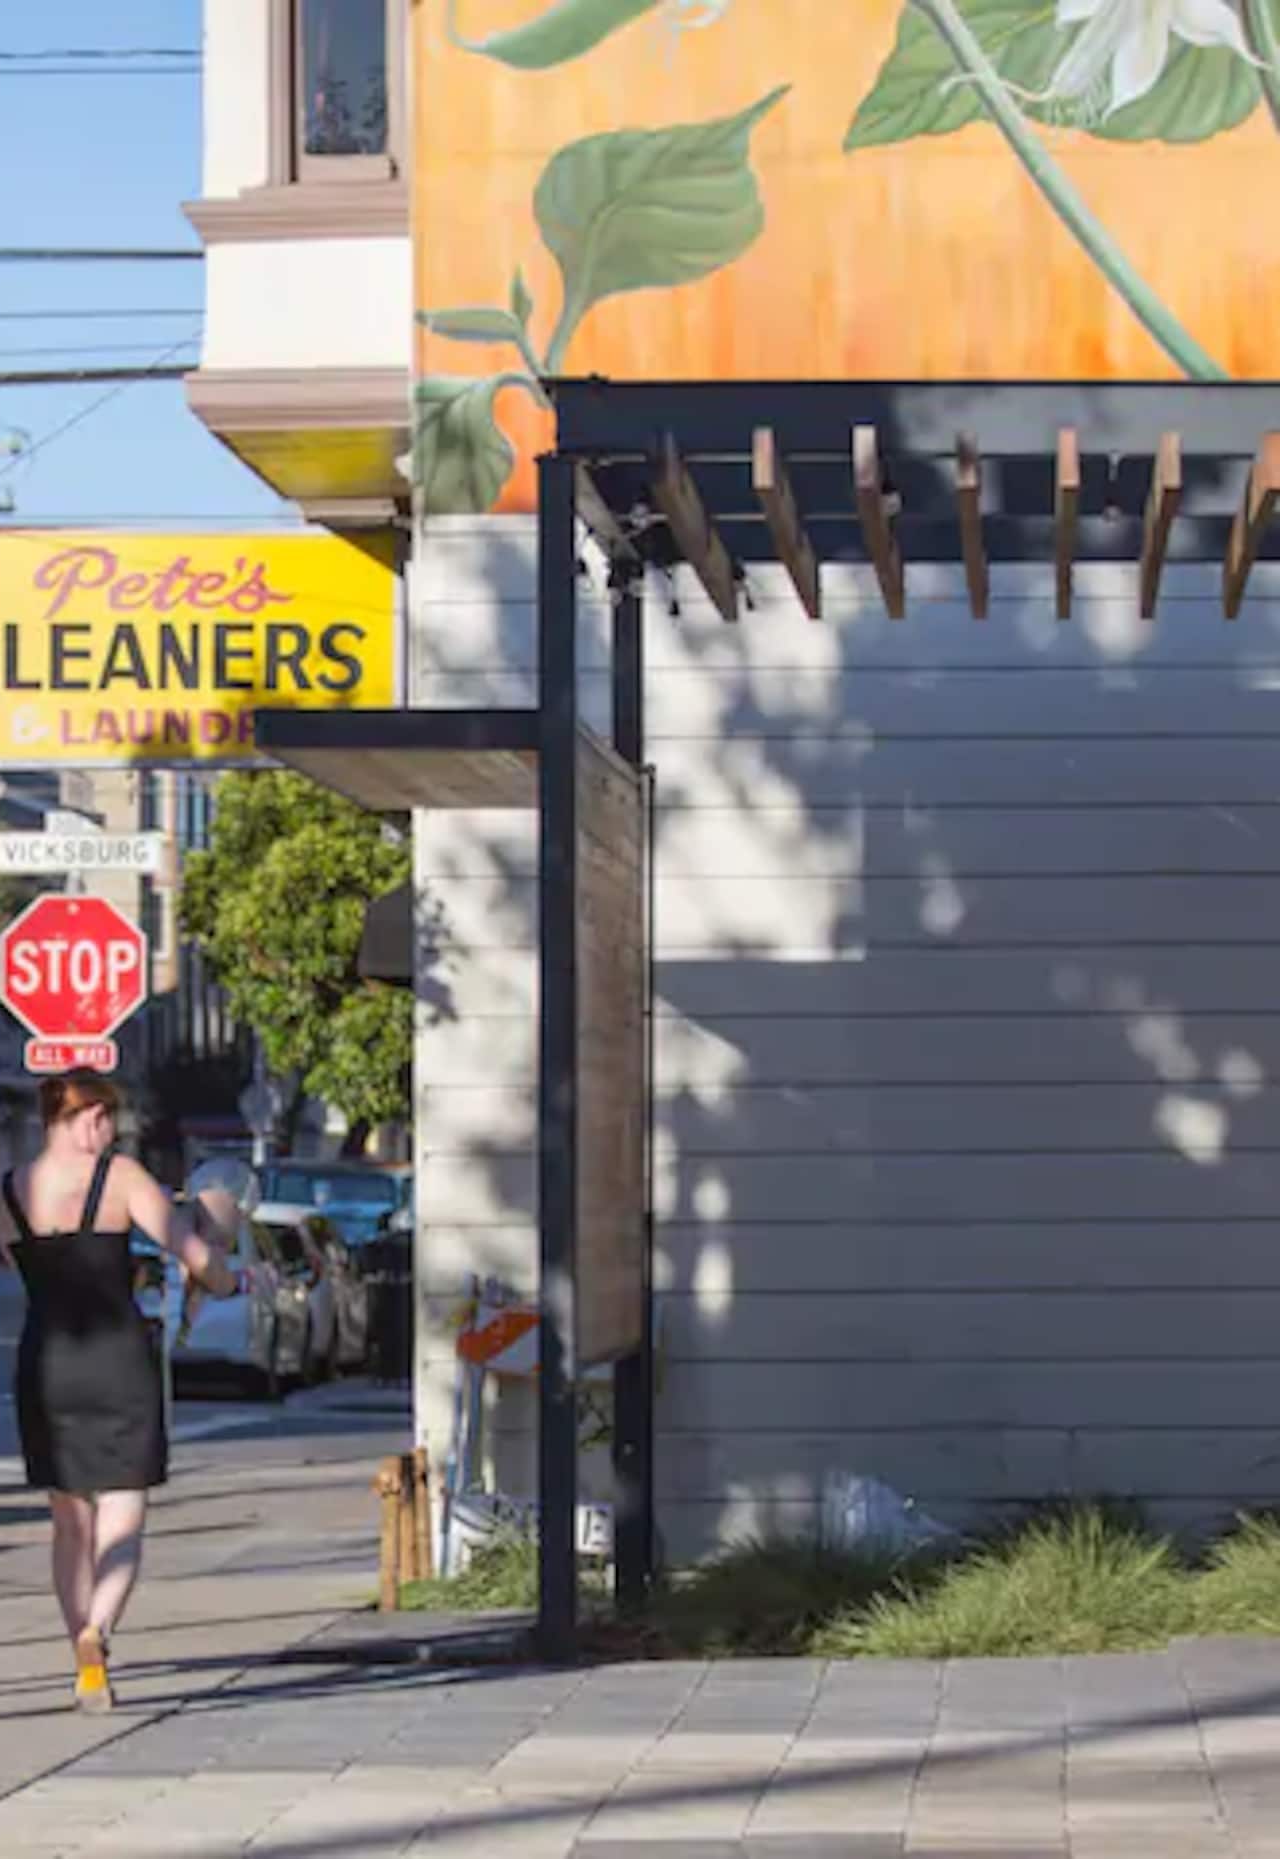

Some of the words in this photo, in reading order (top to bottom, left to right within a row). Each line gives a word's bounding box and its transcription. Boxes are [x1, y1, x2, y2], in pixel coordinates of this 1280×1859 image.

[33, 545, 294, 619] Pete's
[60, 707, 256, 745] LAUND
[4, 839, 149, 864] VICKSBURG
[9, 939, 139, 994] STOP
